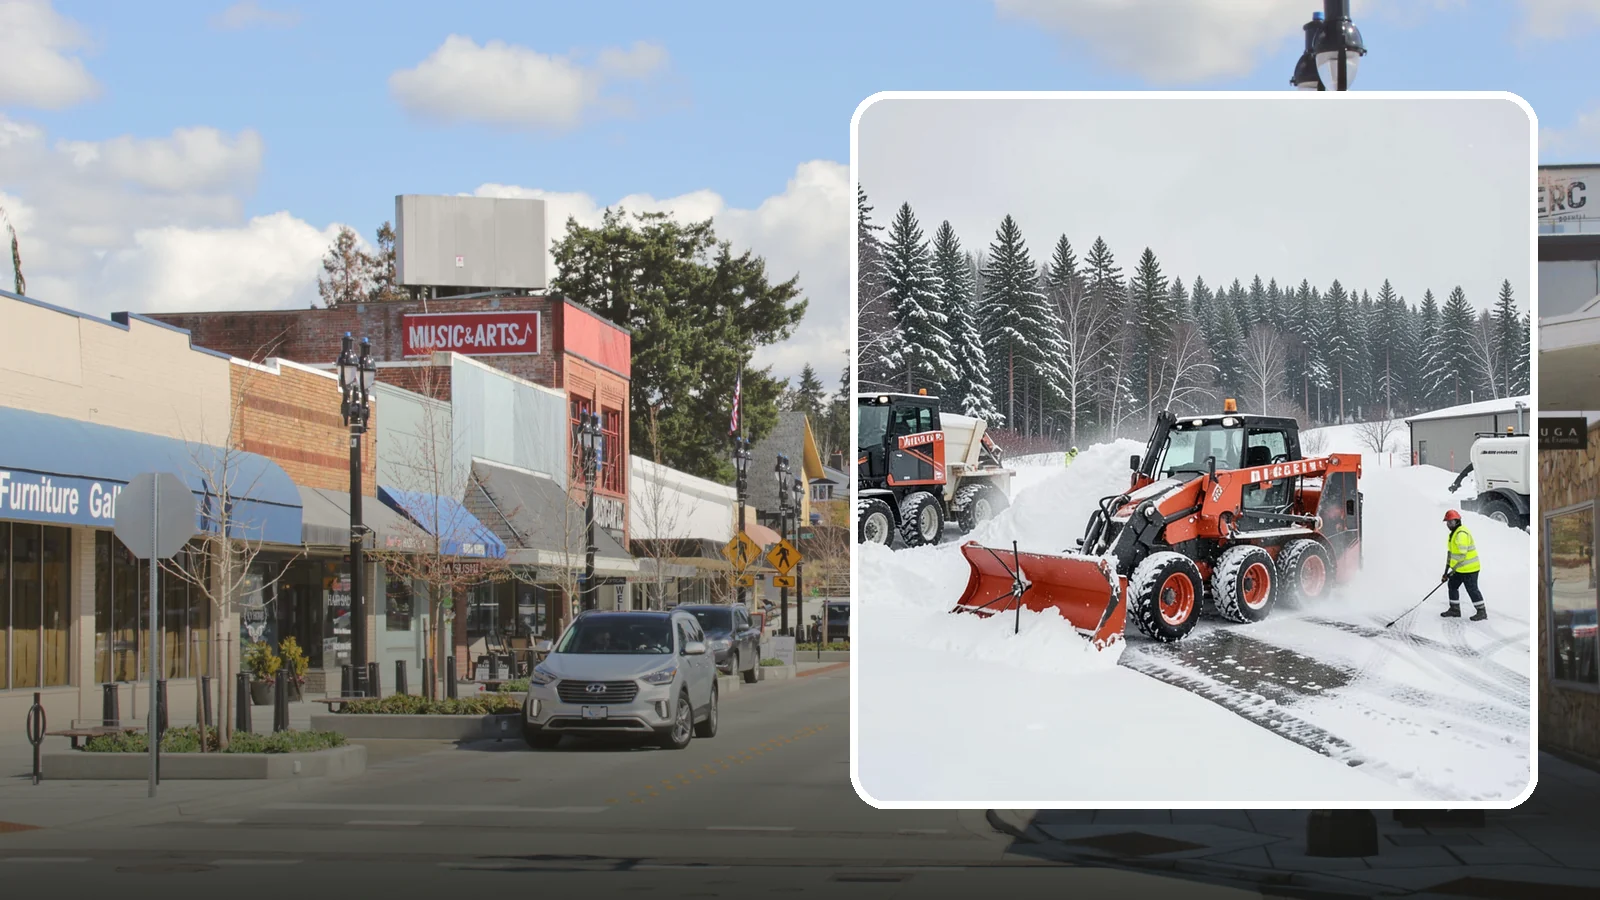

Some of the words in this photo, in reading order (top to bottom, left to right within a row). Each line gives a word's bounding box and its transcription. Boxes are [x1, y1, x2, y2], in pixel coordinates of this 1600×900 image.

[409, 323, 519, 349] MUSIC&ARTS
[0, 472, 79, 515] Furniture
[89, 482, 122, 519] Gal
